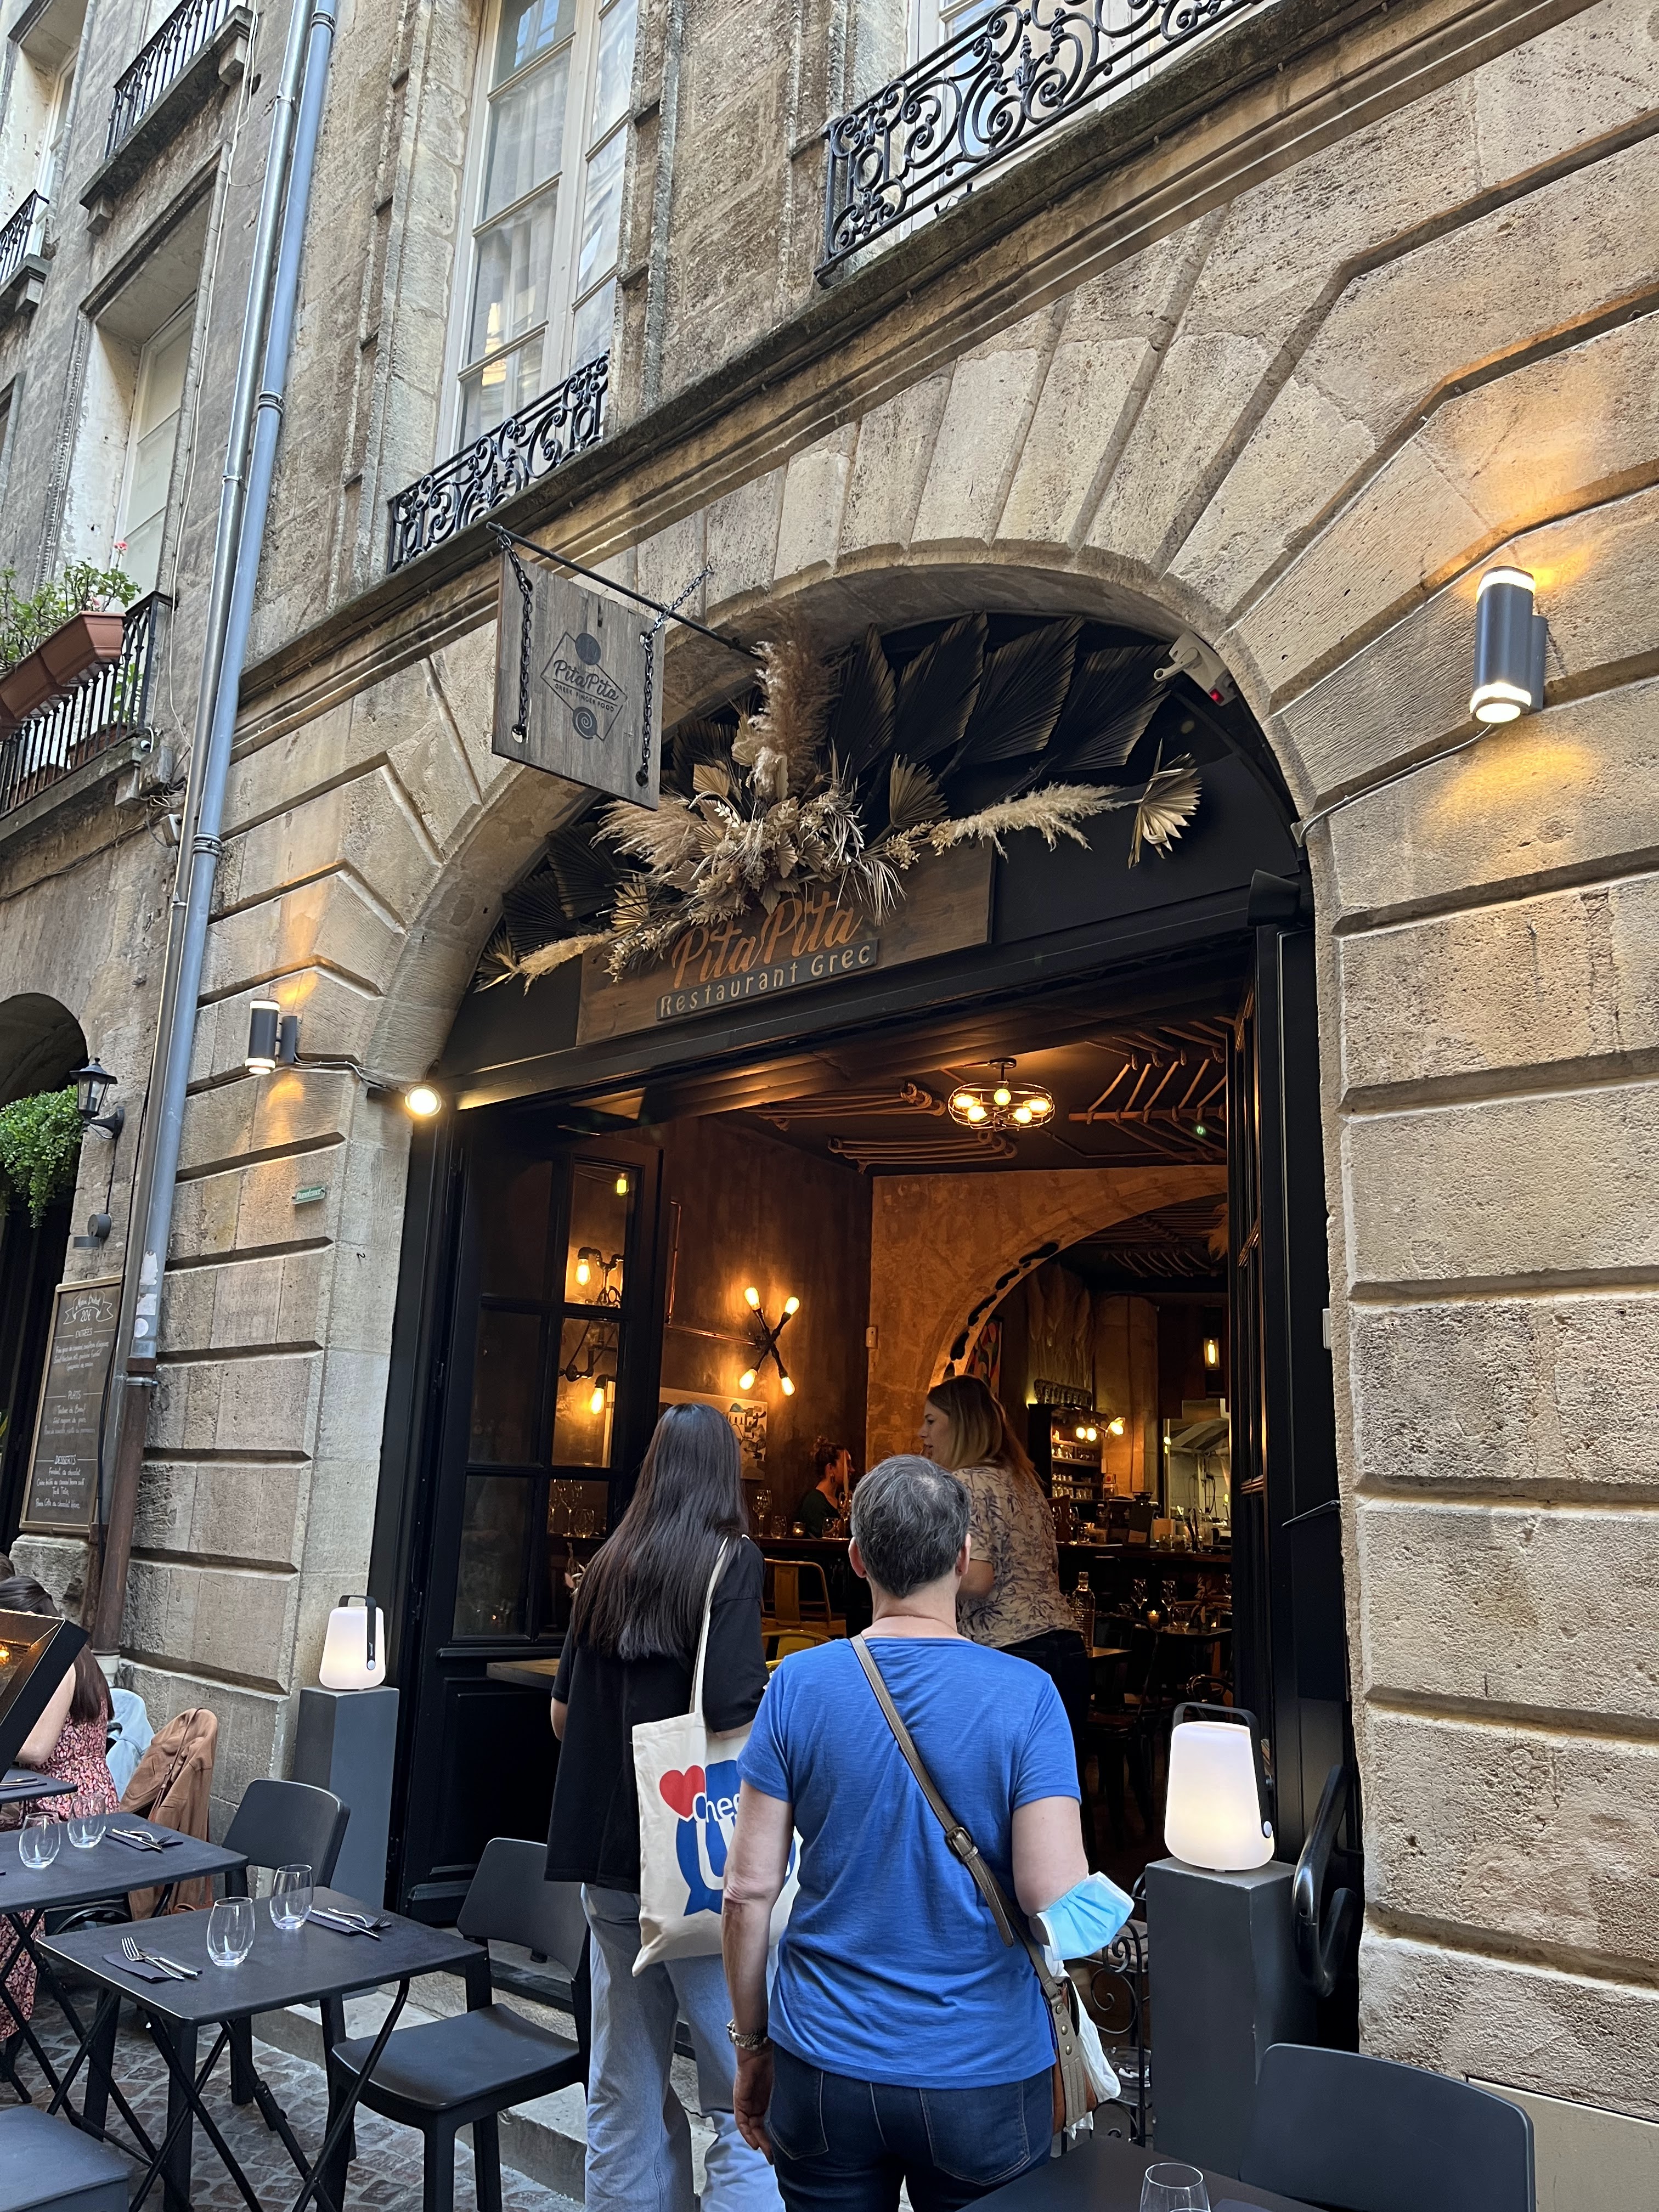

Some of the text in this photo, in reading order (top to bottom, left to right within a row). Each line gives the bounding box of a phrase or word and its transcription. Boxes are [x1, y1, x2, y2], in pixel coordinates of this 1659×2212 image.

[576, 692, 595, 705] FINGER
[598, 701, 614, 712] FOOD
[661, 945, 871, 1018] Restaurant Grec
[67, 1390, 81, 1400] PLATS
[54, 1454, 76, 1465] DESSERTS
